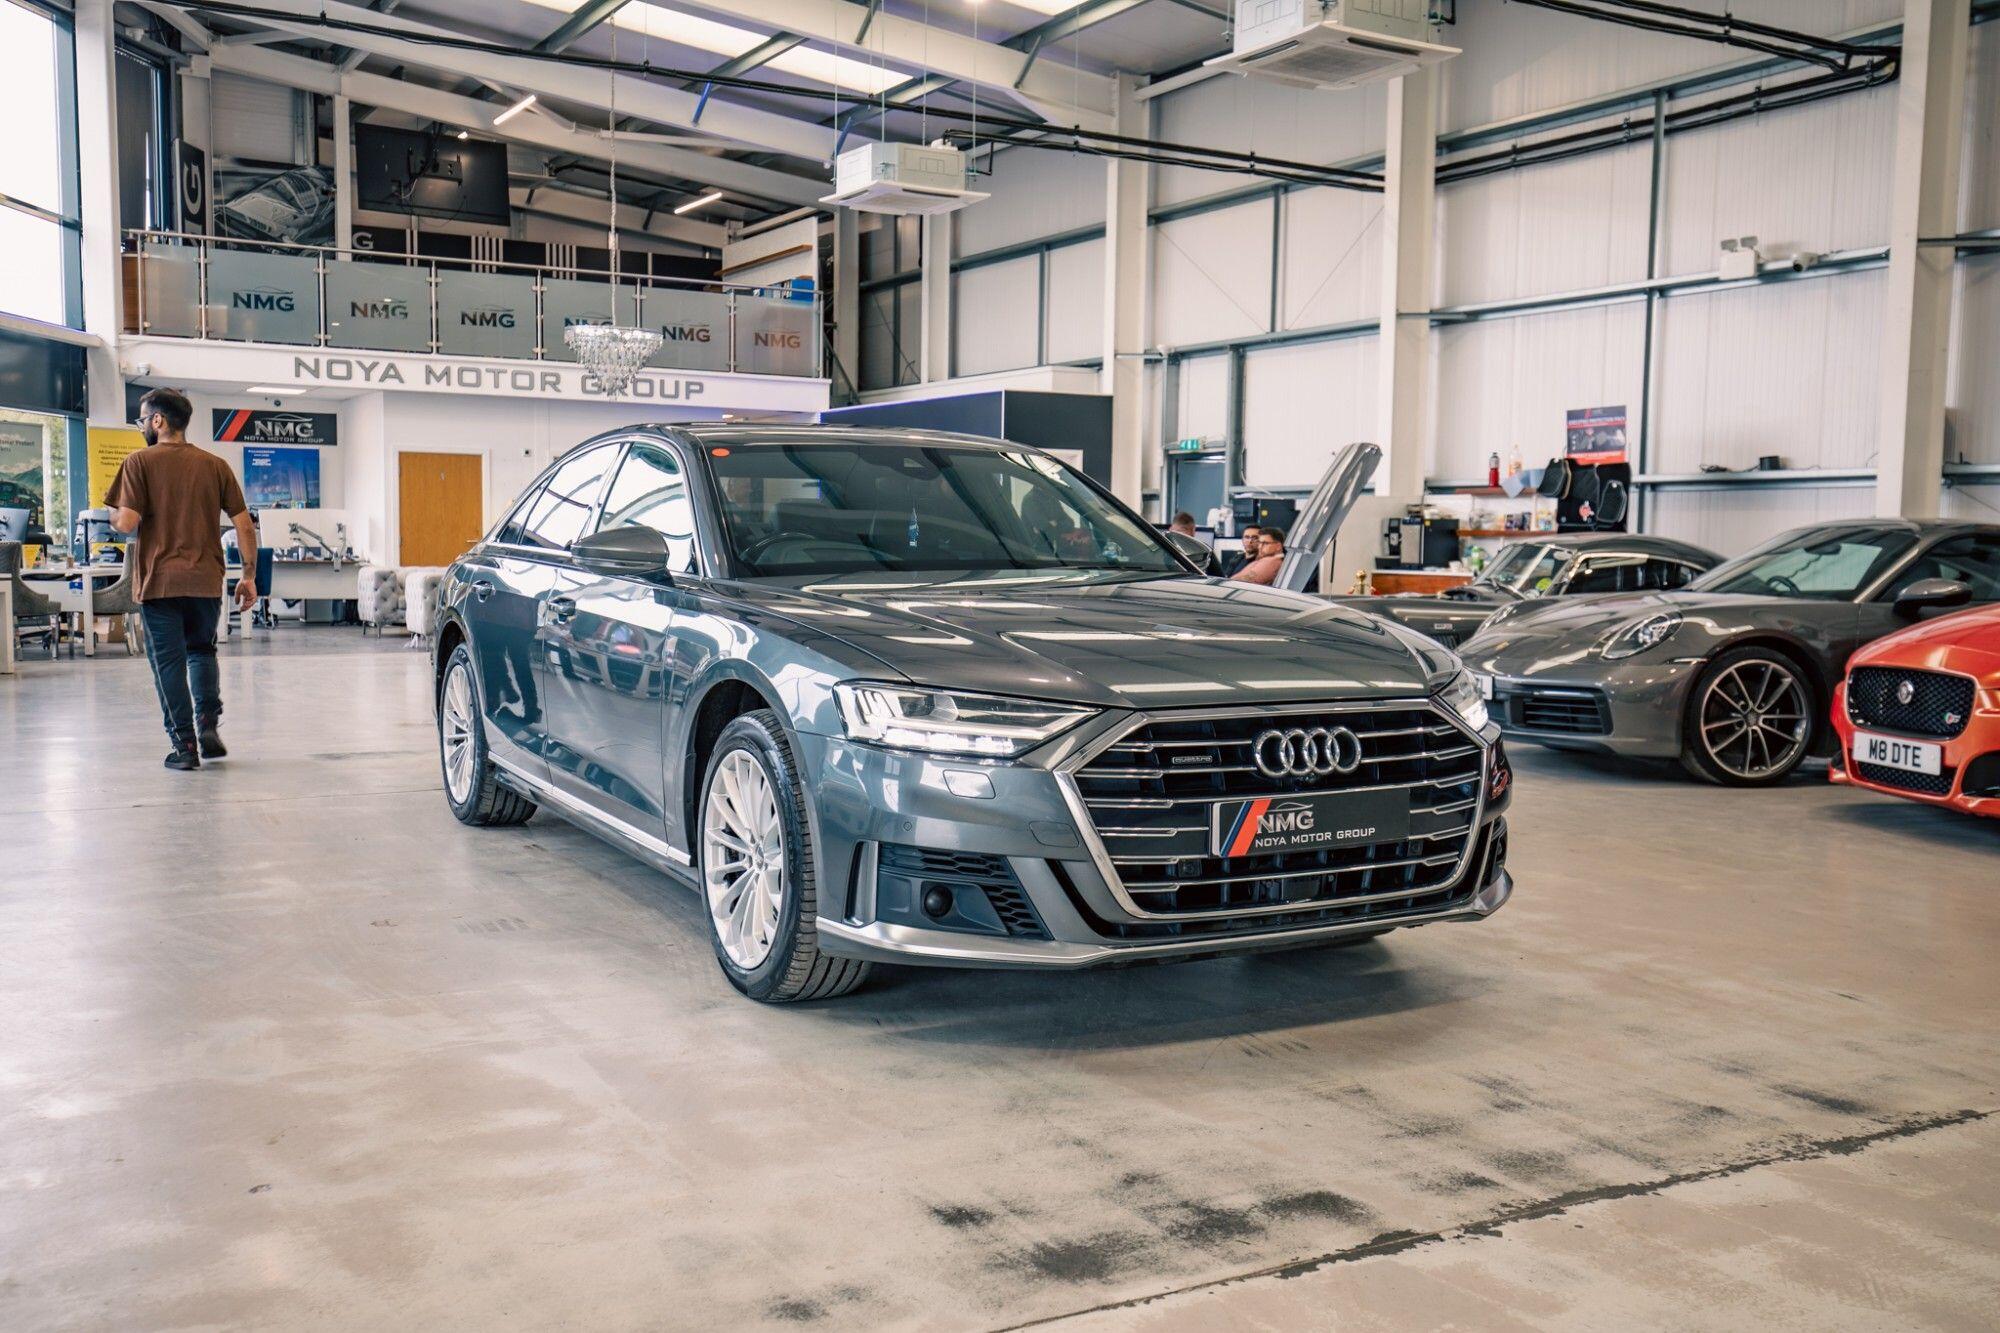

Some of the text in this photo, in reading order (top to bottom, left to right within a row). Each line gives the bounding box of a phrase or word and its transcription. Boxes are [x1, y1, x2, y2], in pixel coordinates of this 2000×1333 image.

[233, 291, 295, 312] NMG
[351, 301, 408, 320] NMG
[460, 311, 515, 328] NMG
[662, 325, 711, 343] NMG
[754, 332, 800, 349] NMG
[294, 357, 405, 384] NOYA
[425, 364, 561, 393] MOTOR
[254, 420, 314, 438] NMG
[1868, 738, 1922, 768] M8 DTE
[1256, 810, 1314, 834] NMG
[1255, 827, 1376, 848] NOYA MOTOR GROUP
